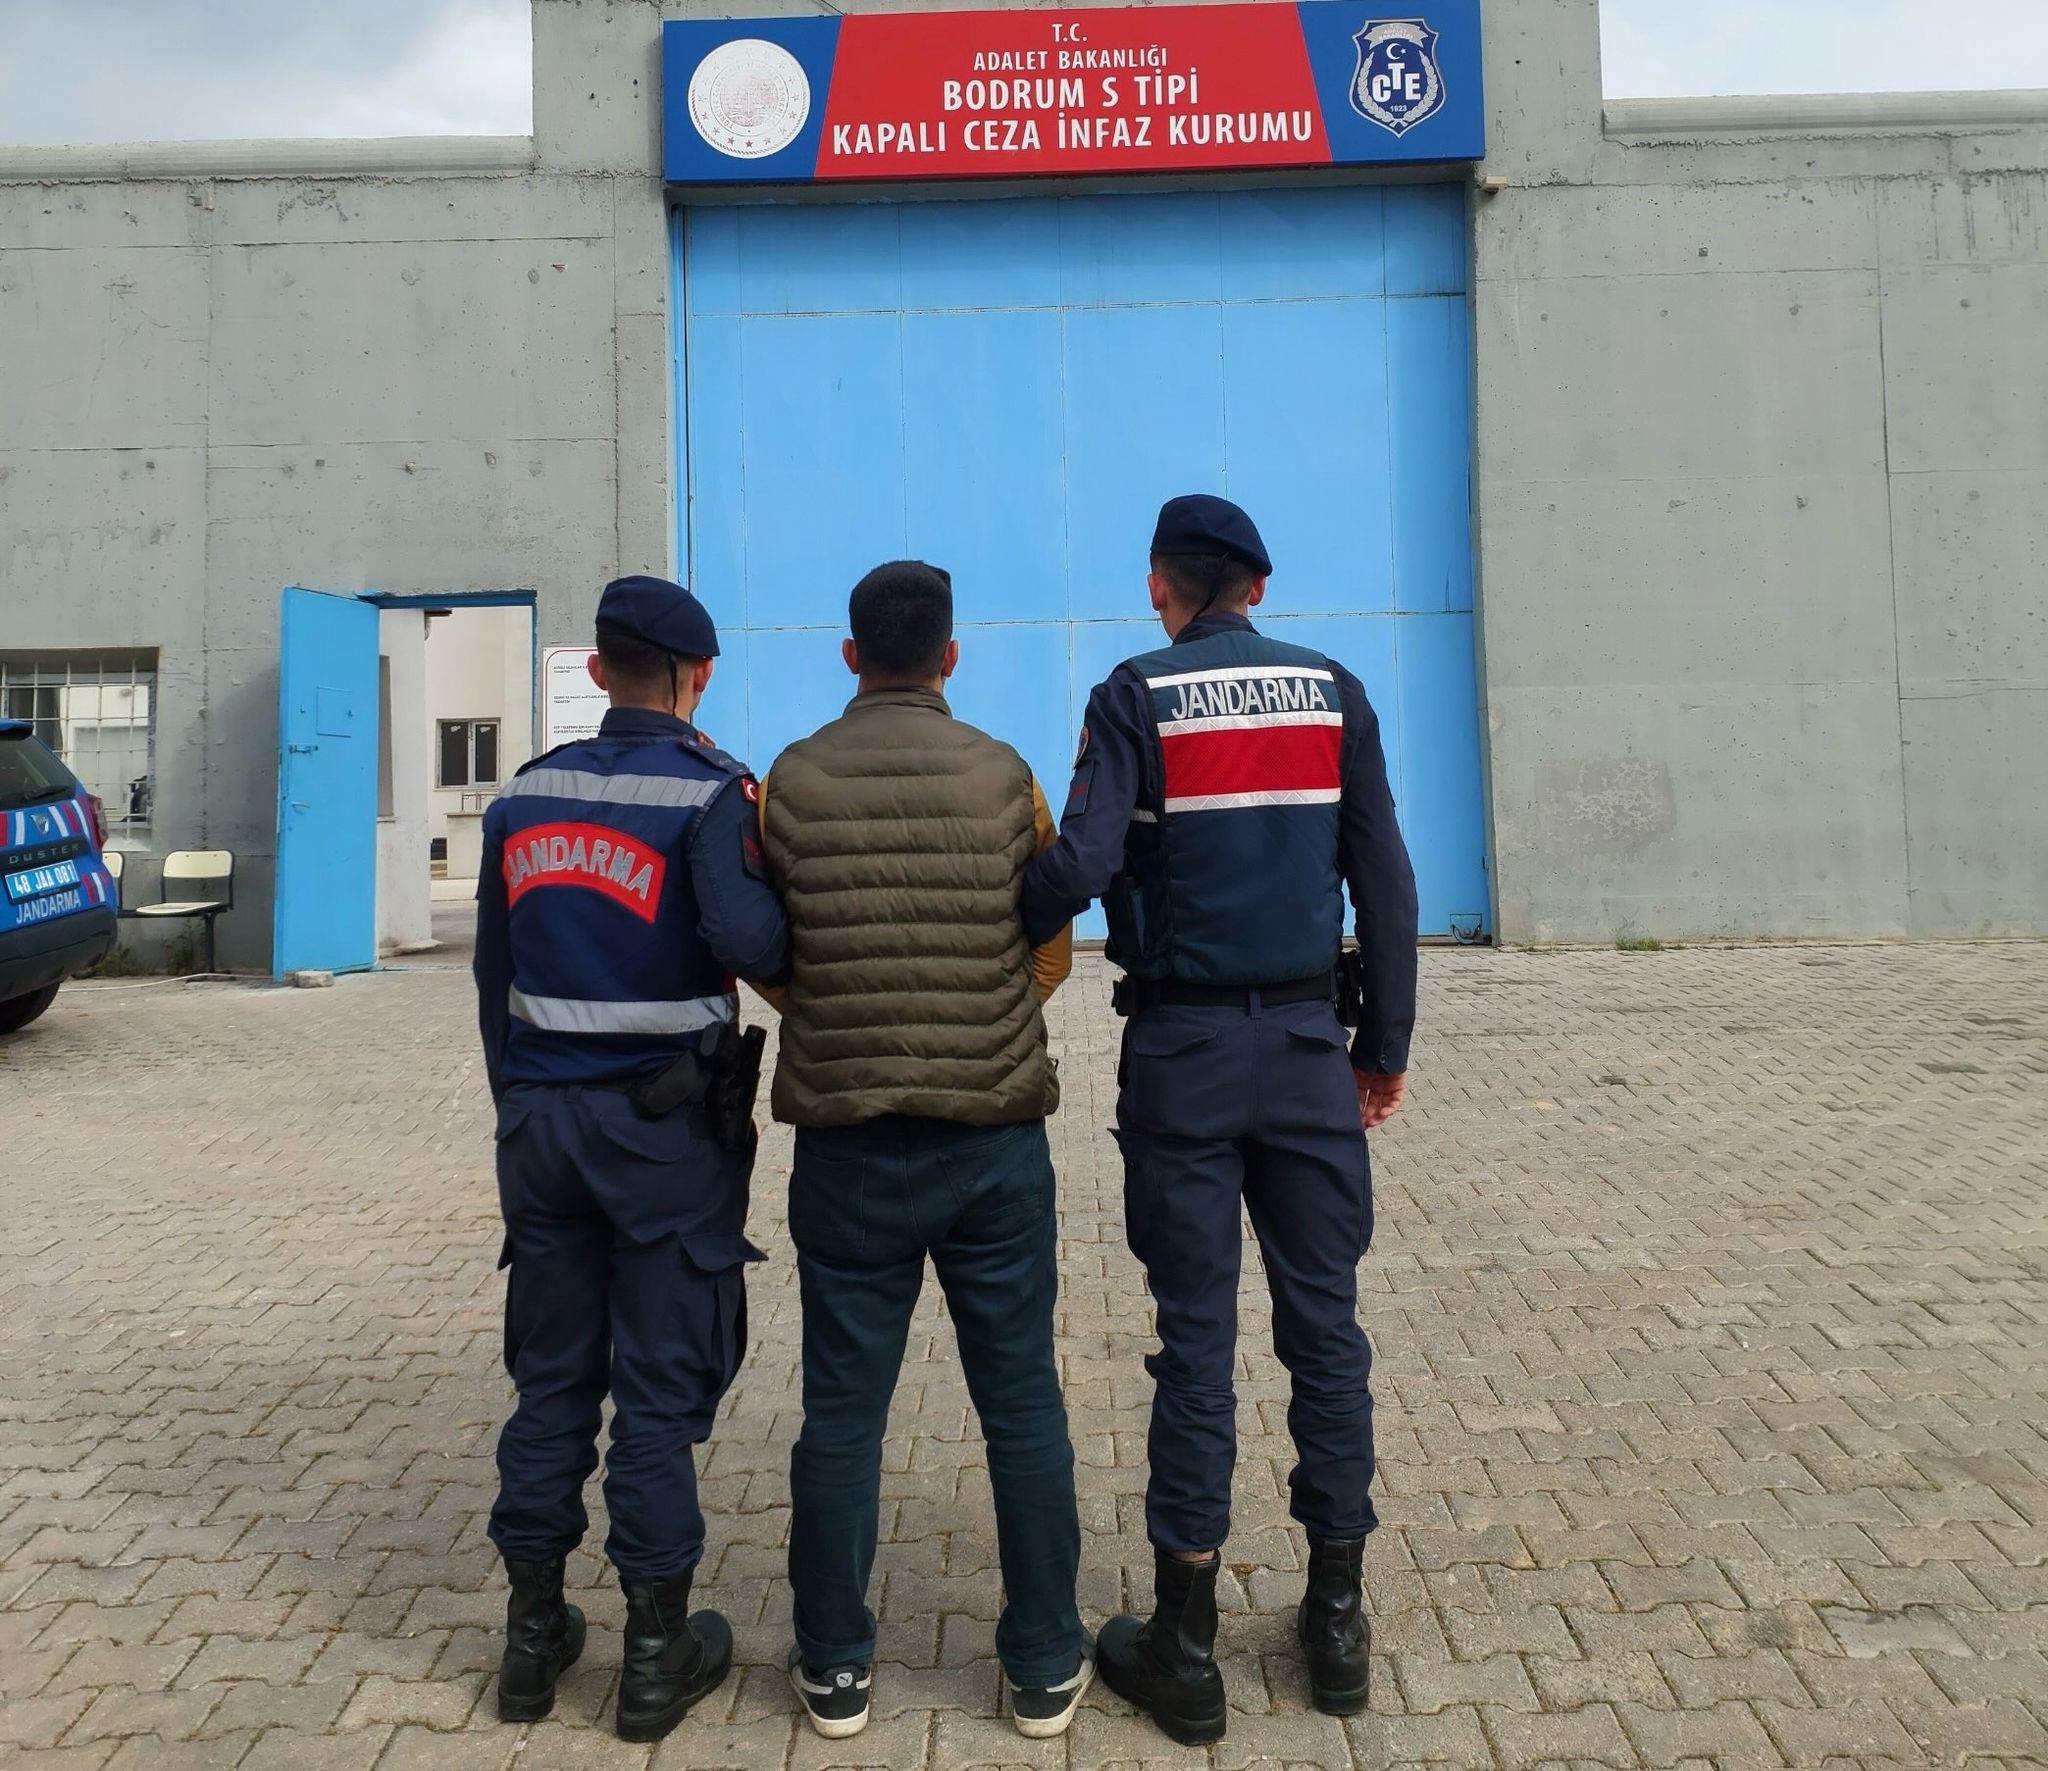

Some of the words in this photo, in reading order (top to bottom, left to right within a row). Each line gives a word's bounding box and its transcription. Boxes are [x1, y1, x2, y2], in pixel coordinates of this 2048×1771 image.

[1051, 23, 1088, 43] T.C.
[973, 51, 1049, 71] ADALET
[1058, 44, 1167, 70] BAKANLIĞI
[943, 77, 1085, 111] BODRUM
[1101, 76, 1119, 108] S
[1133, 66, 1198, 106] TİPİ
[1390, 104, 1408, 112] 1923
[833, 121, 946, 155] KAPALI
[963, 119, 1041, 151] CEZA
[1057, 111, 1152, 149] İNFAZ
[1169, 110, 1312, 146] KURUMU
[1171, 677, 1329, 720] JANDARMA
[8, 843, 80, 865] DUSTER
[506, 836, 654, 901] JANDARMA
[16, 889, 82, 924] JANDARMA
